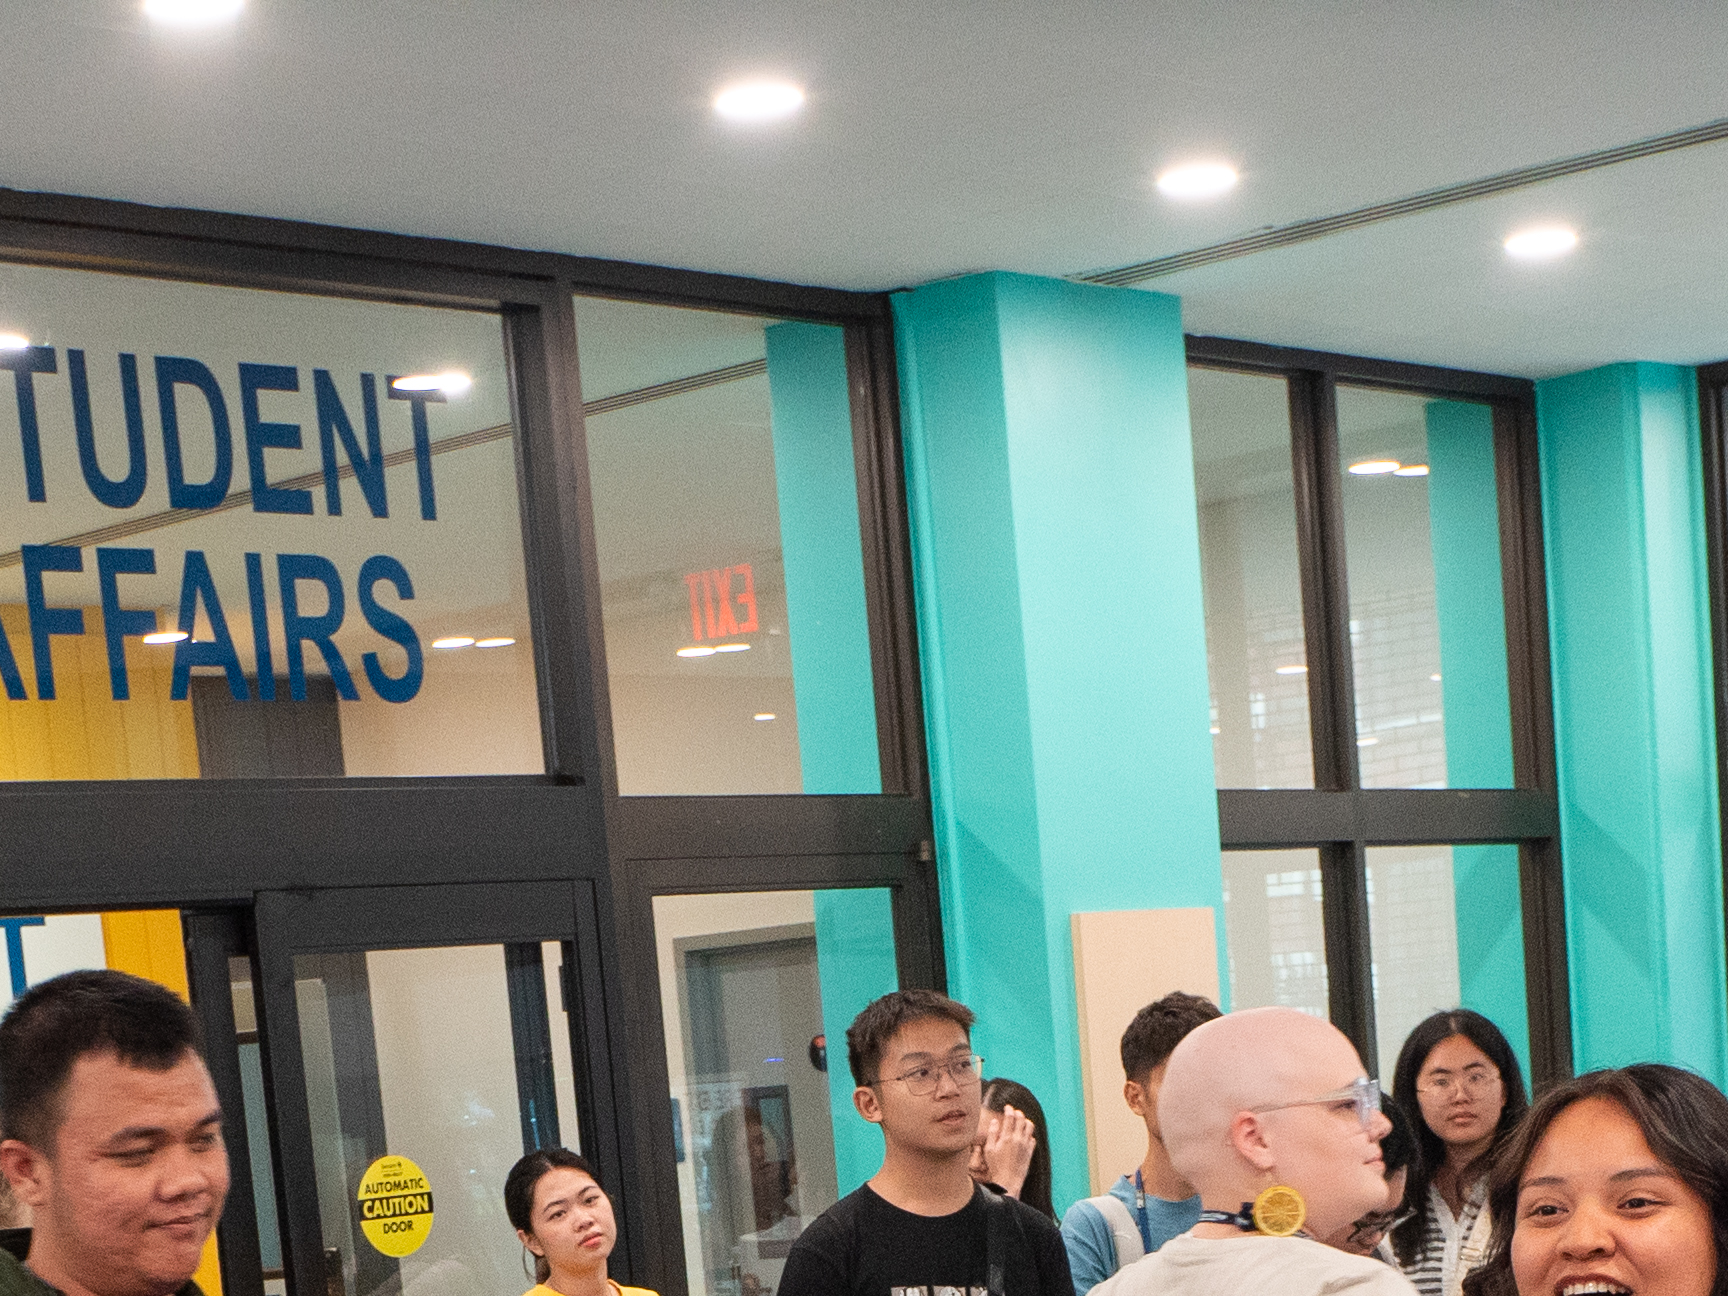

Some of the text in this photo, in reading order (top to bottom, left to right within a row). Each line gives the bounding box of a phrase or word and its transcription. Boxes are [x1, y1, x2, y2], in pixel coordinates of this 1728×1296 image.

[365, 1178, 424, 1195] AUTOMATIC
[363, 1194, 429, 1219] CAUTION
[383, 1220, 413, 1234] DOOR
